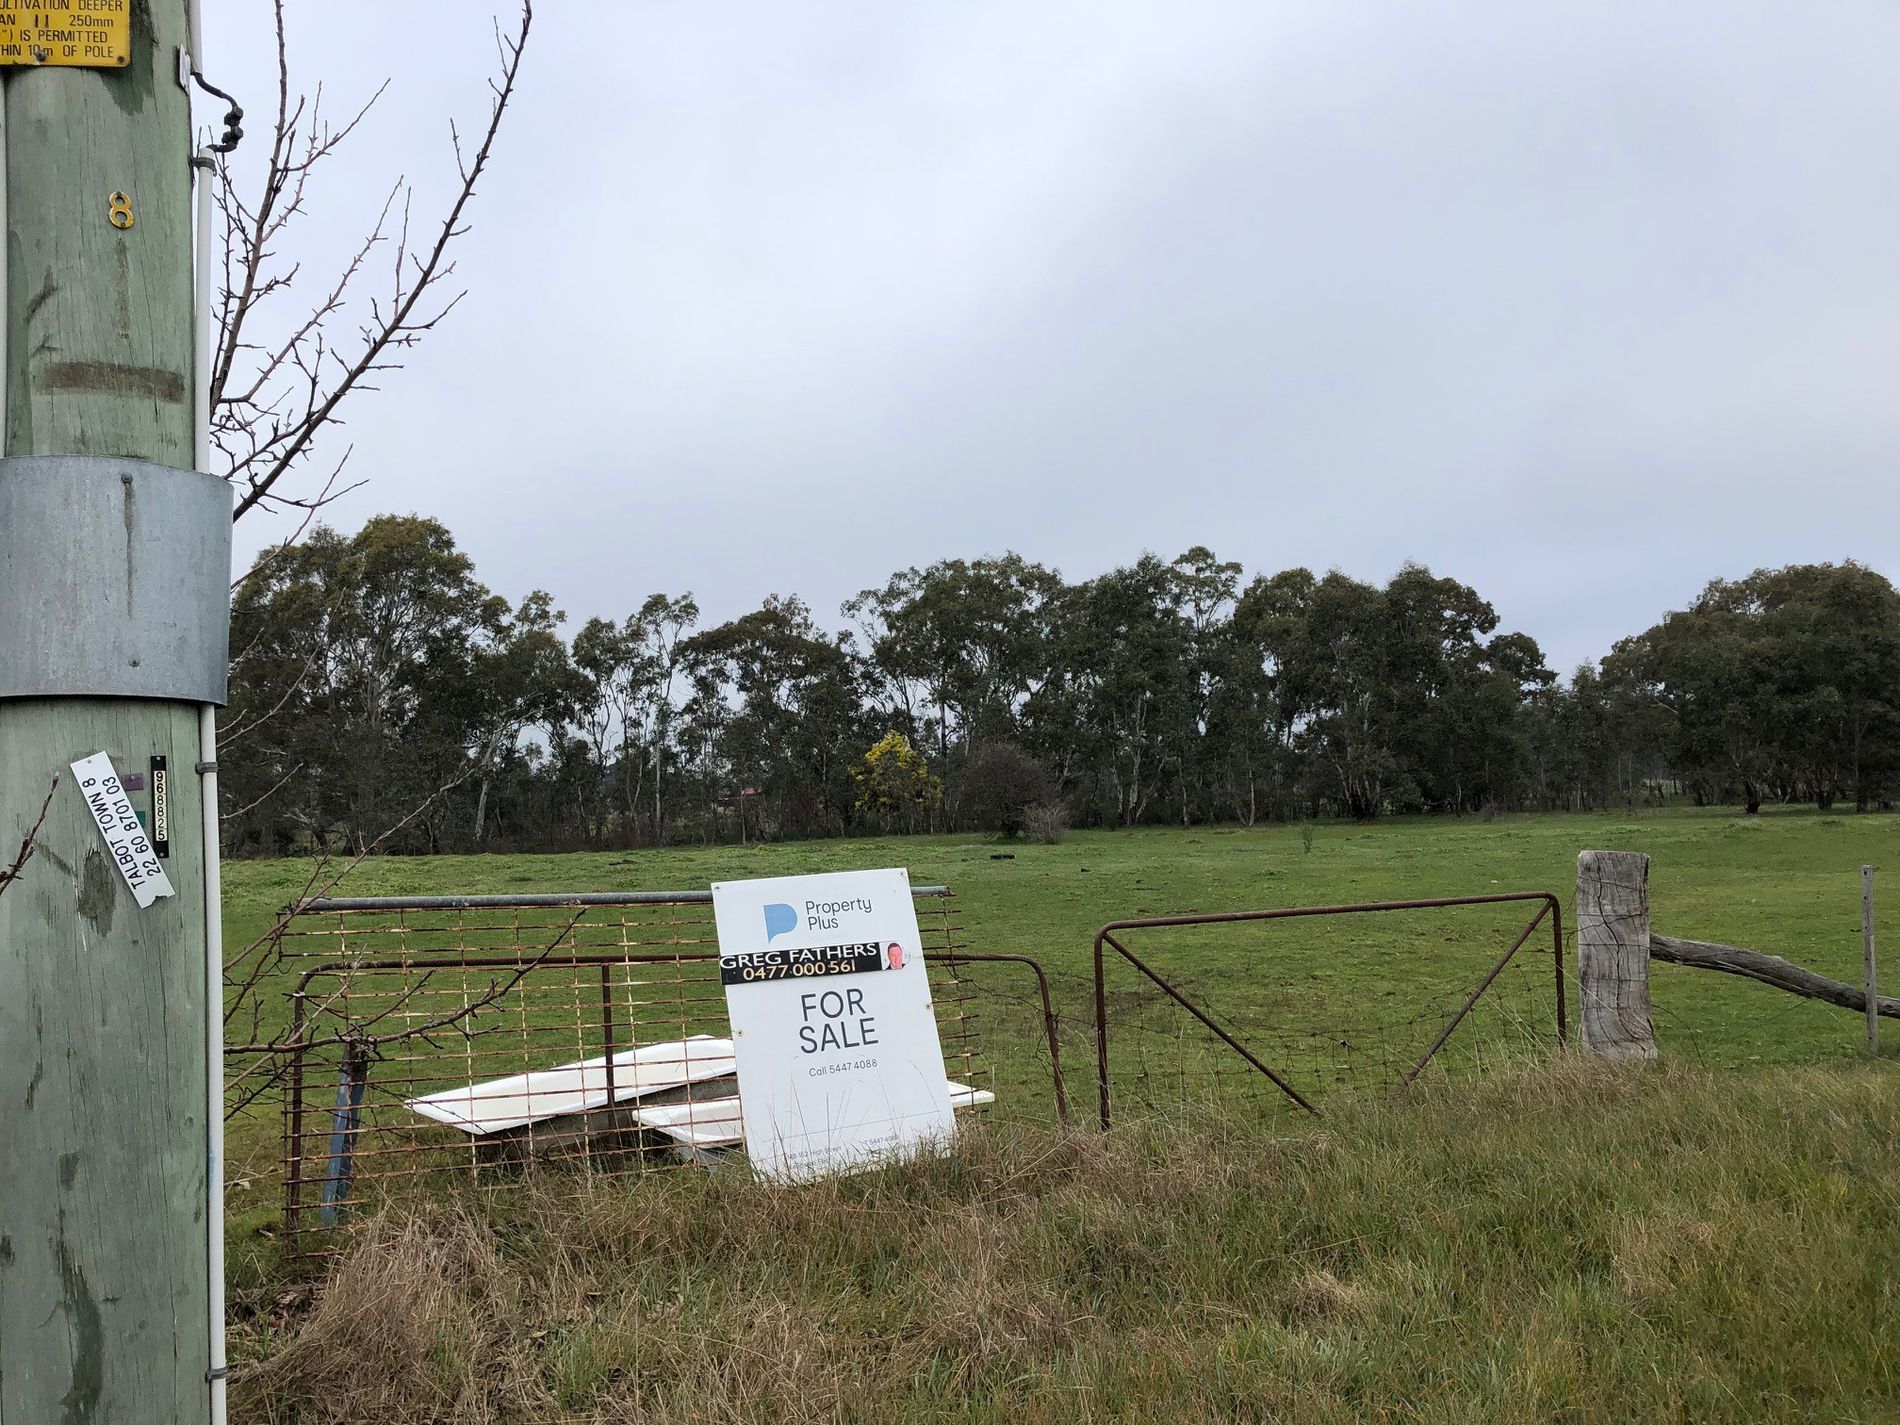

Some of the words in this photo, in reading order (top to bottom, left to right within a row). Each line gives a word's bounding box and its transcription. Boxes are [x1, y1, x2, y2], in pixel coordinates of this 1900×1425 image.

[78, 0, 123, 12] DEEPER
[68, 14, 114, 28] 250mm
[19, 29, 31, 42] IS
[37, 29, 108, 43] PERMITTED
[0, 44, 22, 57] HIN
[62, 44, 77, 57] OF
[84, 45, 114, 58] POLE
[109, 191, 134, 228] 8
[82, 777, 96, 788] 8
[102, 776, 120, 795] 03
[88, 792, 117, 834] TOWN
[114, 798, 138, 832] 8701
[153, 771, 168, 841] 968825
[131, 835, 149, 854] 60
[109, 838, 146, 890] TALBOT
[142, 858, 161, 876] 22
[805, 897, 873, 916] Property
[808, 915, 839, 931] Plus
[719, 951, 781, 969] GREG
[789, 943, 877, 963] FATHERS
[743, 965, 789, 981] 0477
[792, 962, 827, 977] 000
[829, 959, 856, 974] 561
[801, 988, 866, 1022] FOR
[799, 1017, 879, 1054] SALE
[809, 1066, 827, 1077] Call
[829, 1062, 852, 1074] 5447
[853, 1058, 878, 1070] 4088
